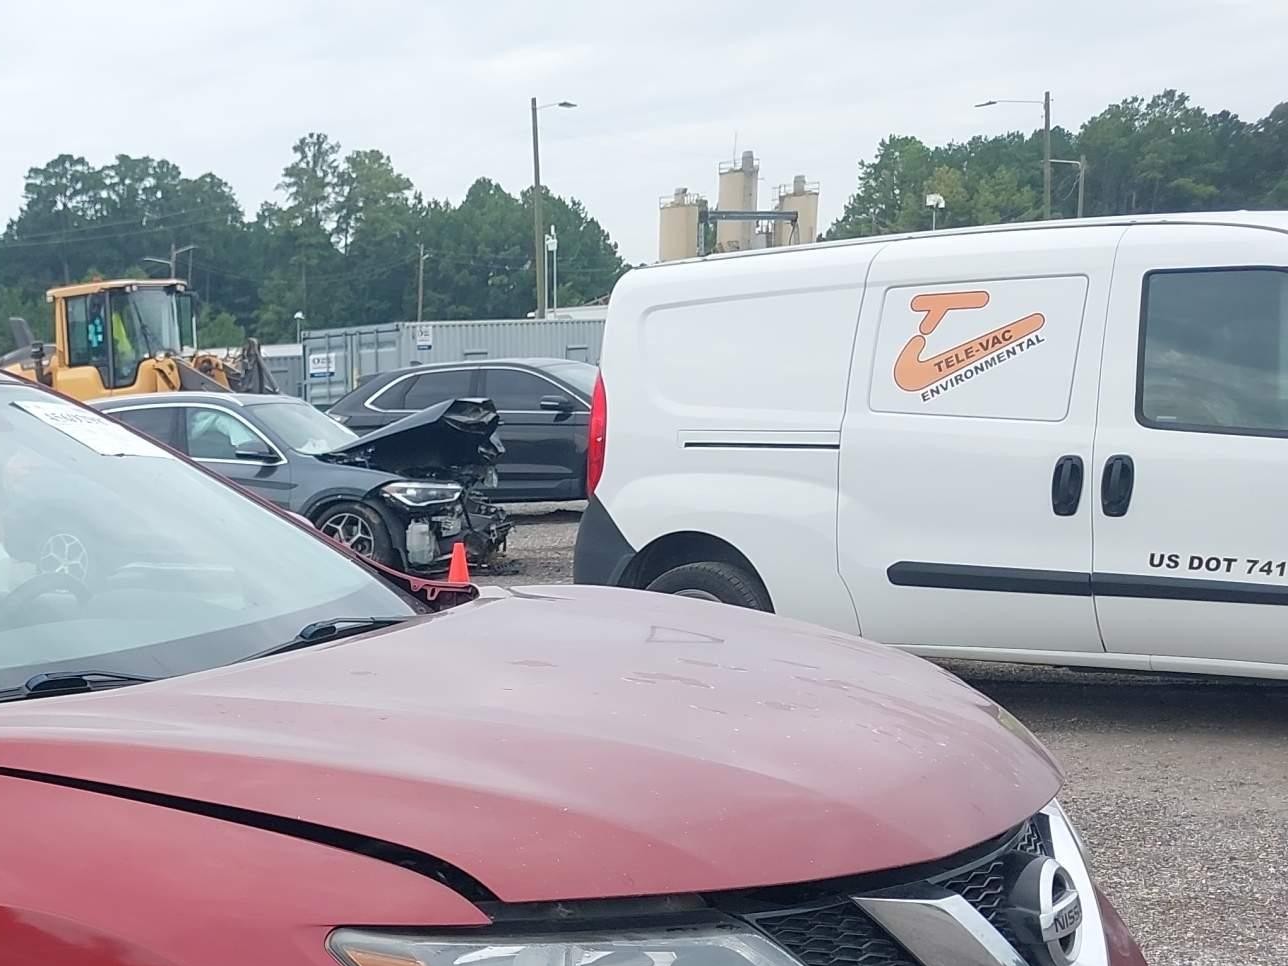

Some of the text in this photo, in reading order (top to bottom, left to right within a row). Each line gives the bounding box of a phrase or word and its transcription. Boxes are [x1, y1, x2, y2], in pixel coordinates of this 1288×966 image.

[920, 334, 1045, 402] ENVIRONMENTAL
[933, 329, 1014, 373] TELE-VAC
[1148, 553, 1287, 577] US DOT 741
